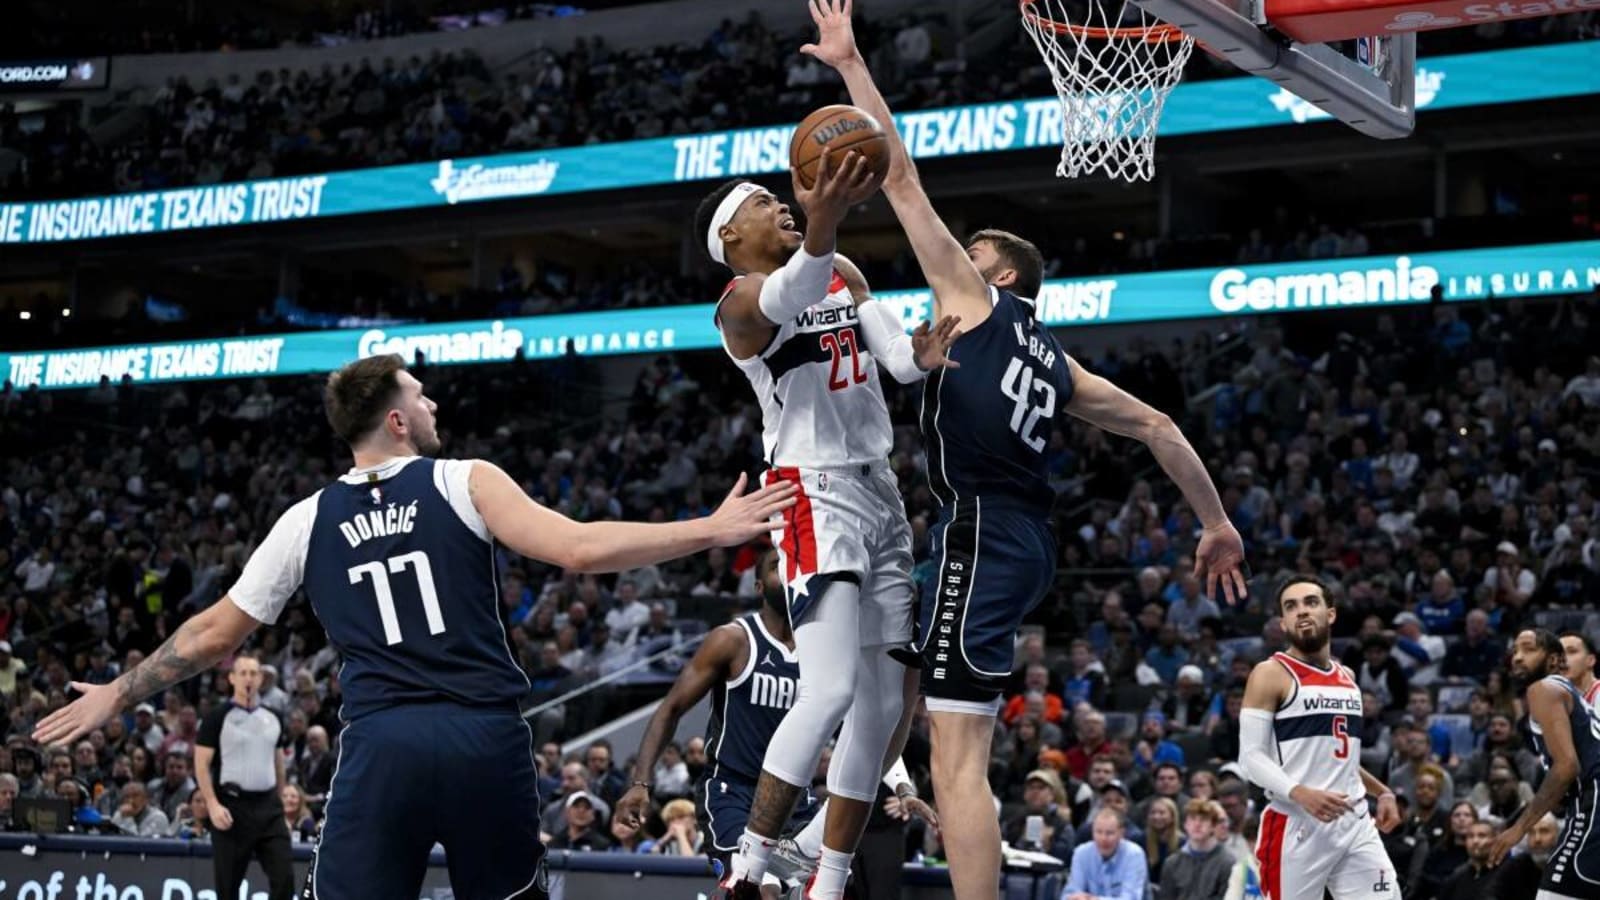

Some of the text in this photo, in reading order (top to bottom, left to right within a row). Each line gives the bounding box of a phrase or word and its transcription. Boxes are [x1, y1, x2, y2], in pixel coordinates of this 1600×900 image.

[0, 65, 67, 82] ORD.COM
[674, 135, 727, 180] THE
[901, 103, 1018, 158] TEXANS
[814, 118, 873, 145] Wilson
[27, 193, 158, 241] INSURANCE
[161, 184, 247, 230] TEXANS
[252, 176, 327, 222] TRUST
[1209, 256, 1439, 312] Germania
[9, 338, 284, 386] THE INSURANCE TEXANS TRUST
[358, 320, 675, 364] Germania INSURANCE
[820, 327, 868, 392] 22
[1000, 356, 1056, 453] 42
[338, 499, 418, 548] DONČIĆ
[347, 550, 446, 646] 77
[1332, 714, 1350, 760] 5
